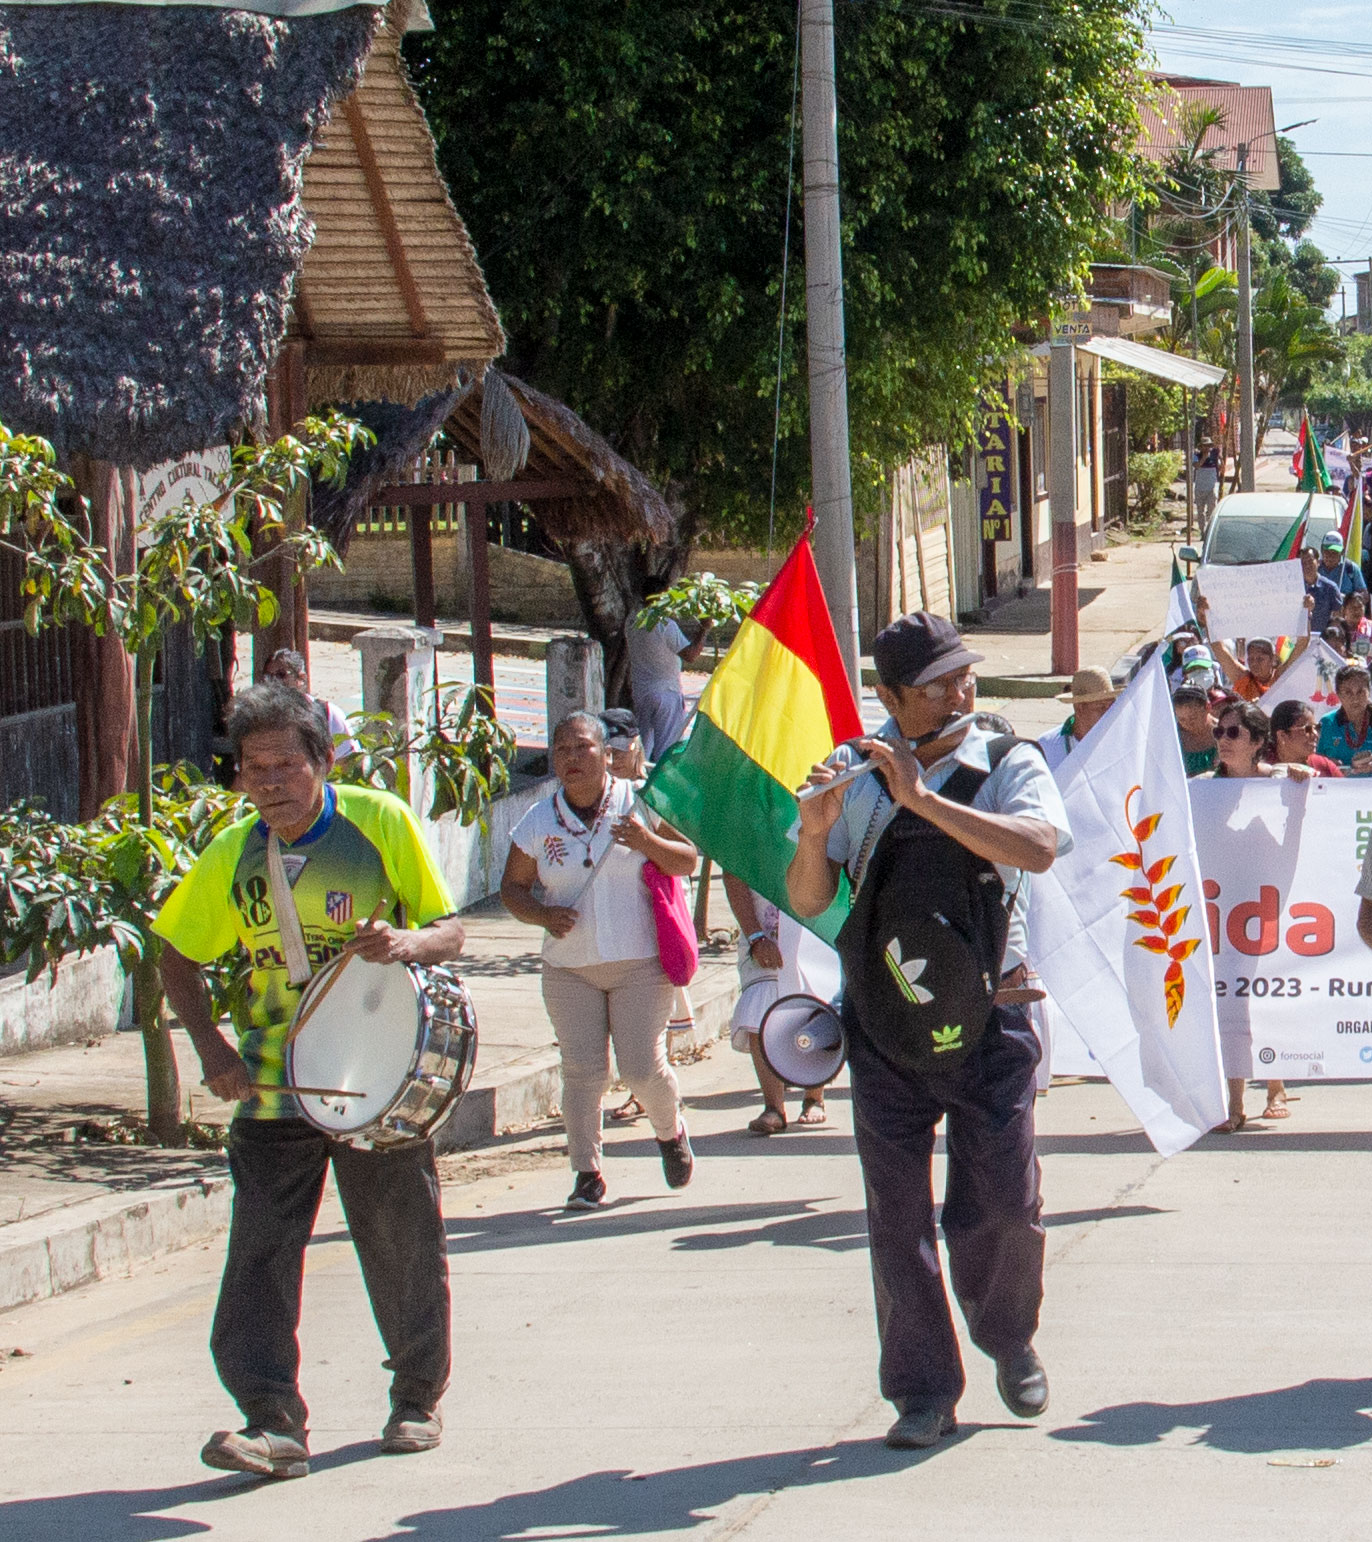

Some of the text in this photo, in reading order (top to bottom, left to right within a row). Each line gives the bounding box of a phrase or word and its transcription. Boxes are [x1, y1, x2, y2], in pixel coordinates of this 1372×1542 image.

[1054, 323, 1090, 335] VENTA
[139, 480, 167, 524] CENTRO
[167, 462, 202, 487] CULTURAL
[1003, 518, 1011, 540] 1
[1202, 878, 1336, 957] ida
[1235, 977, 1302, 997] 2023
[1280, 1051, 1324, 1060] forosocial
